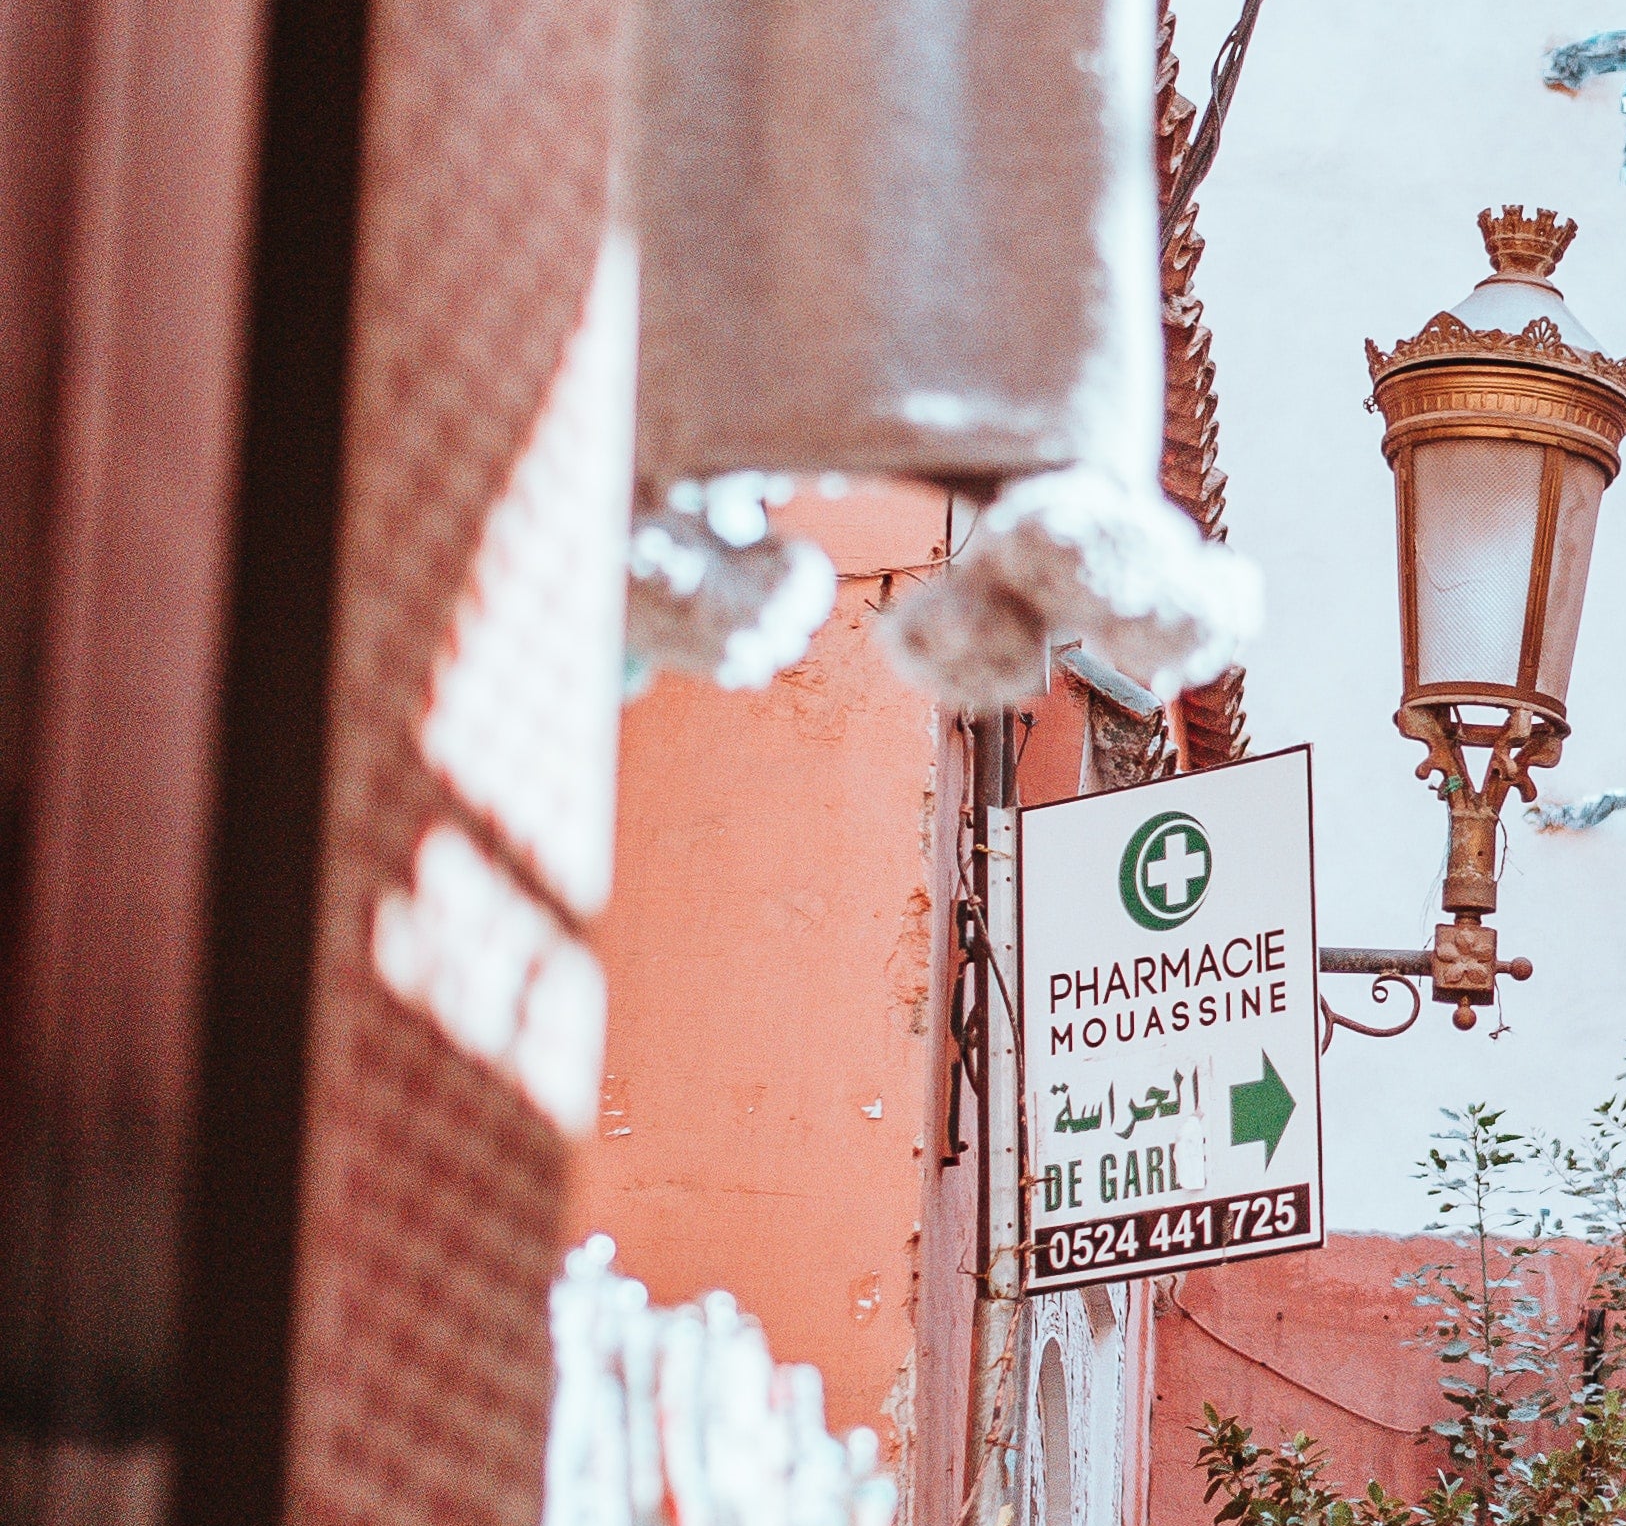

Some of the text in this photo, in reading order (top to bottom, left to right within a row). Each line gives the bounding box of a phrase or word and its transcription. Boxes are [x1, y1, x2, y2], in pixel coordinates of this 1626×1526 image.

[1051, 929, 1285, 1012] PHARMACIE
[1051, 982, 1286, 1054] MOUASSINE
[1051, 1067, 1199, 1139] الحراسة
[1044, 1138, 1206, 1212] DE GAR
[1050, 1192, 1297, 1269] 0524 441 725
